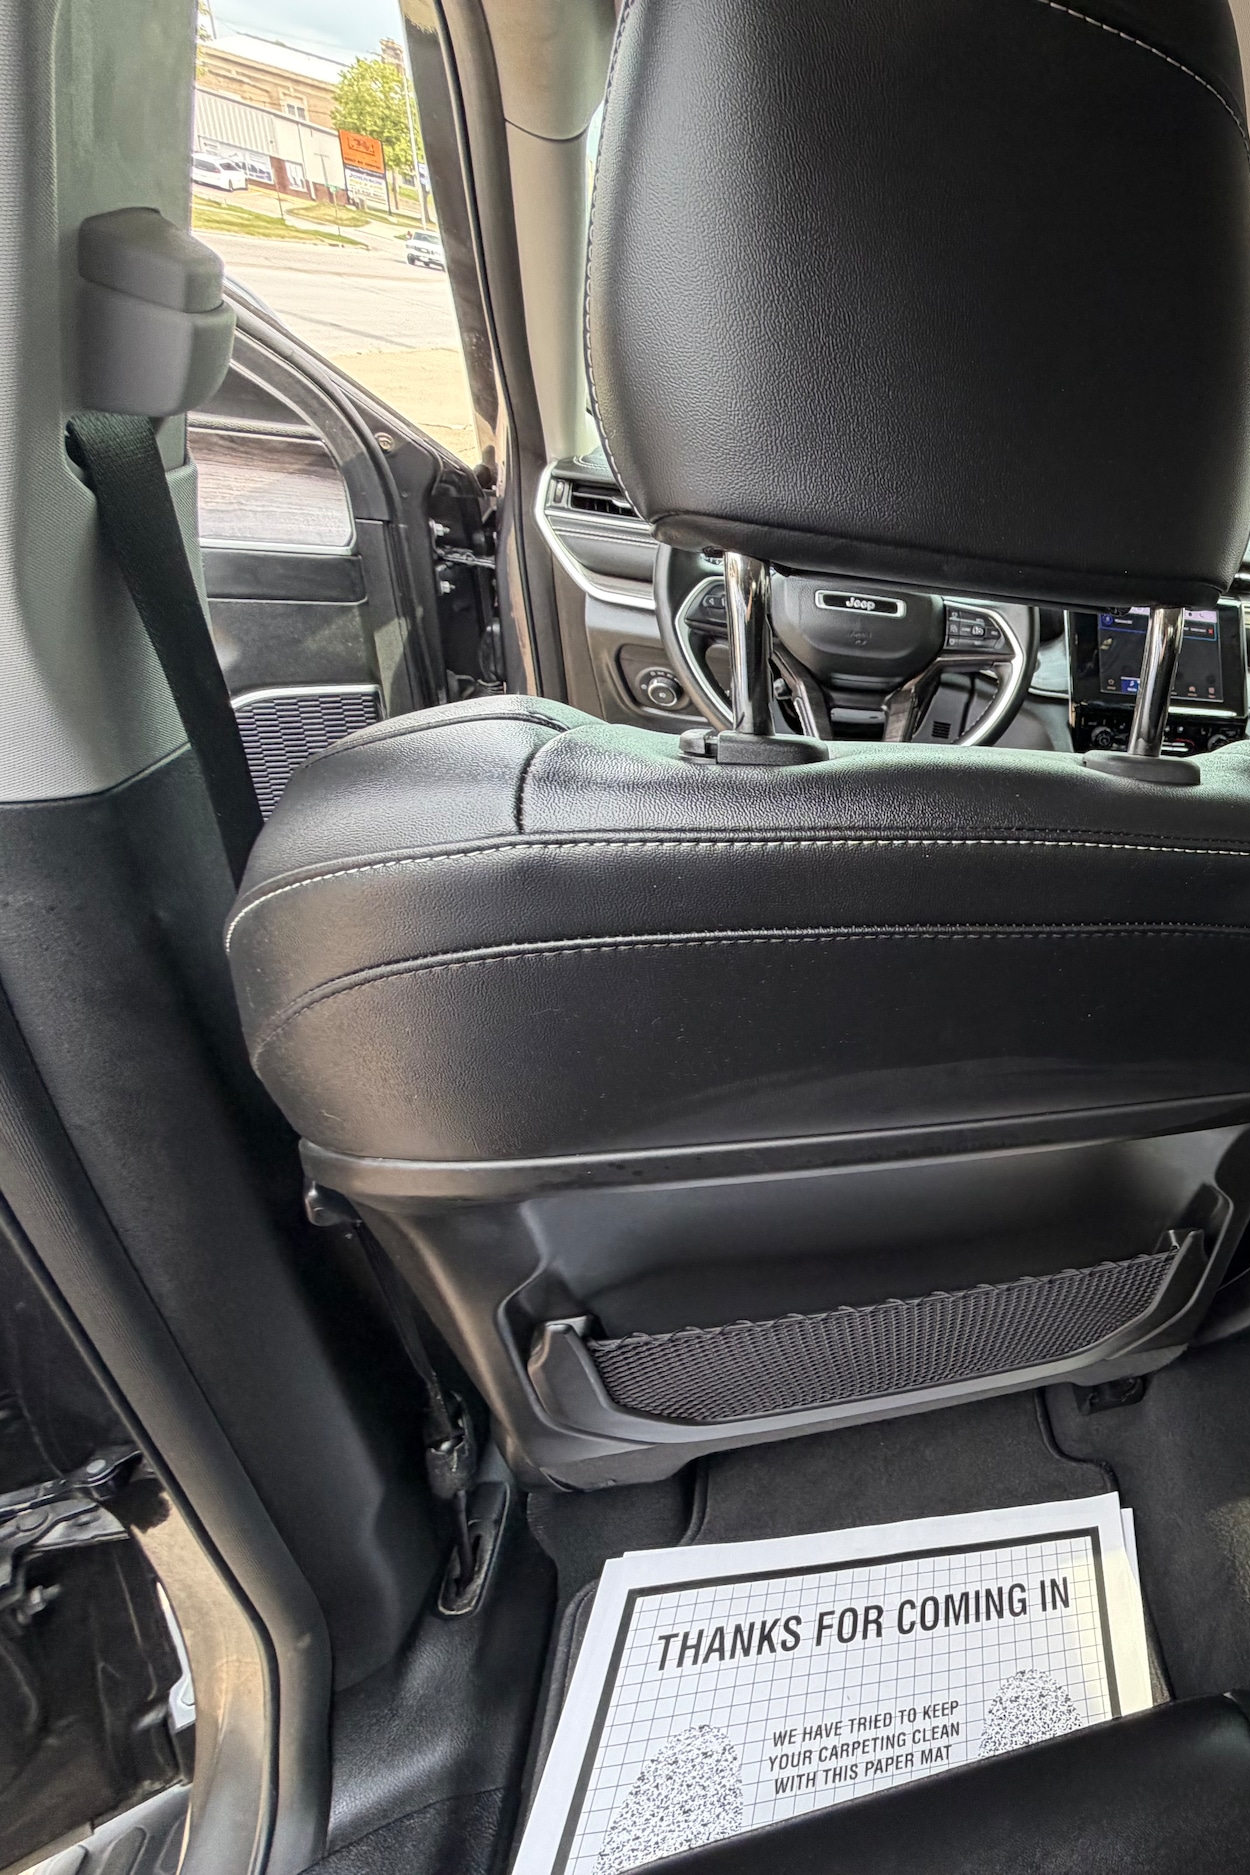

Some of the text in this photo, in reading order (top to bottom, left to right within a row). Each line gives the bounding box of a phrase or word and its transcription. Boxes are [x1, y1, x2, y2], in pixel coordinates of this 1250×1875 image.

[845, 596, 876, 611] Jeep
[657, 1576, 1070, 1671] THANKS FOR COMING IN
[768, 1721, 961, 1772] YOUR CARPETING CLEAN
[773, 1700, 959, 1747] WE HAVE TRIED TO KEEP
[774, 1745, 952, 1794] WITH THIS PAPER MAT
